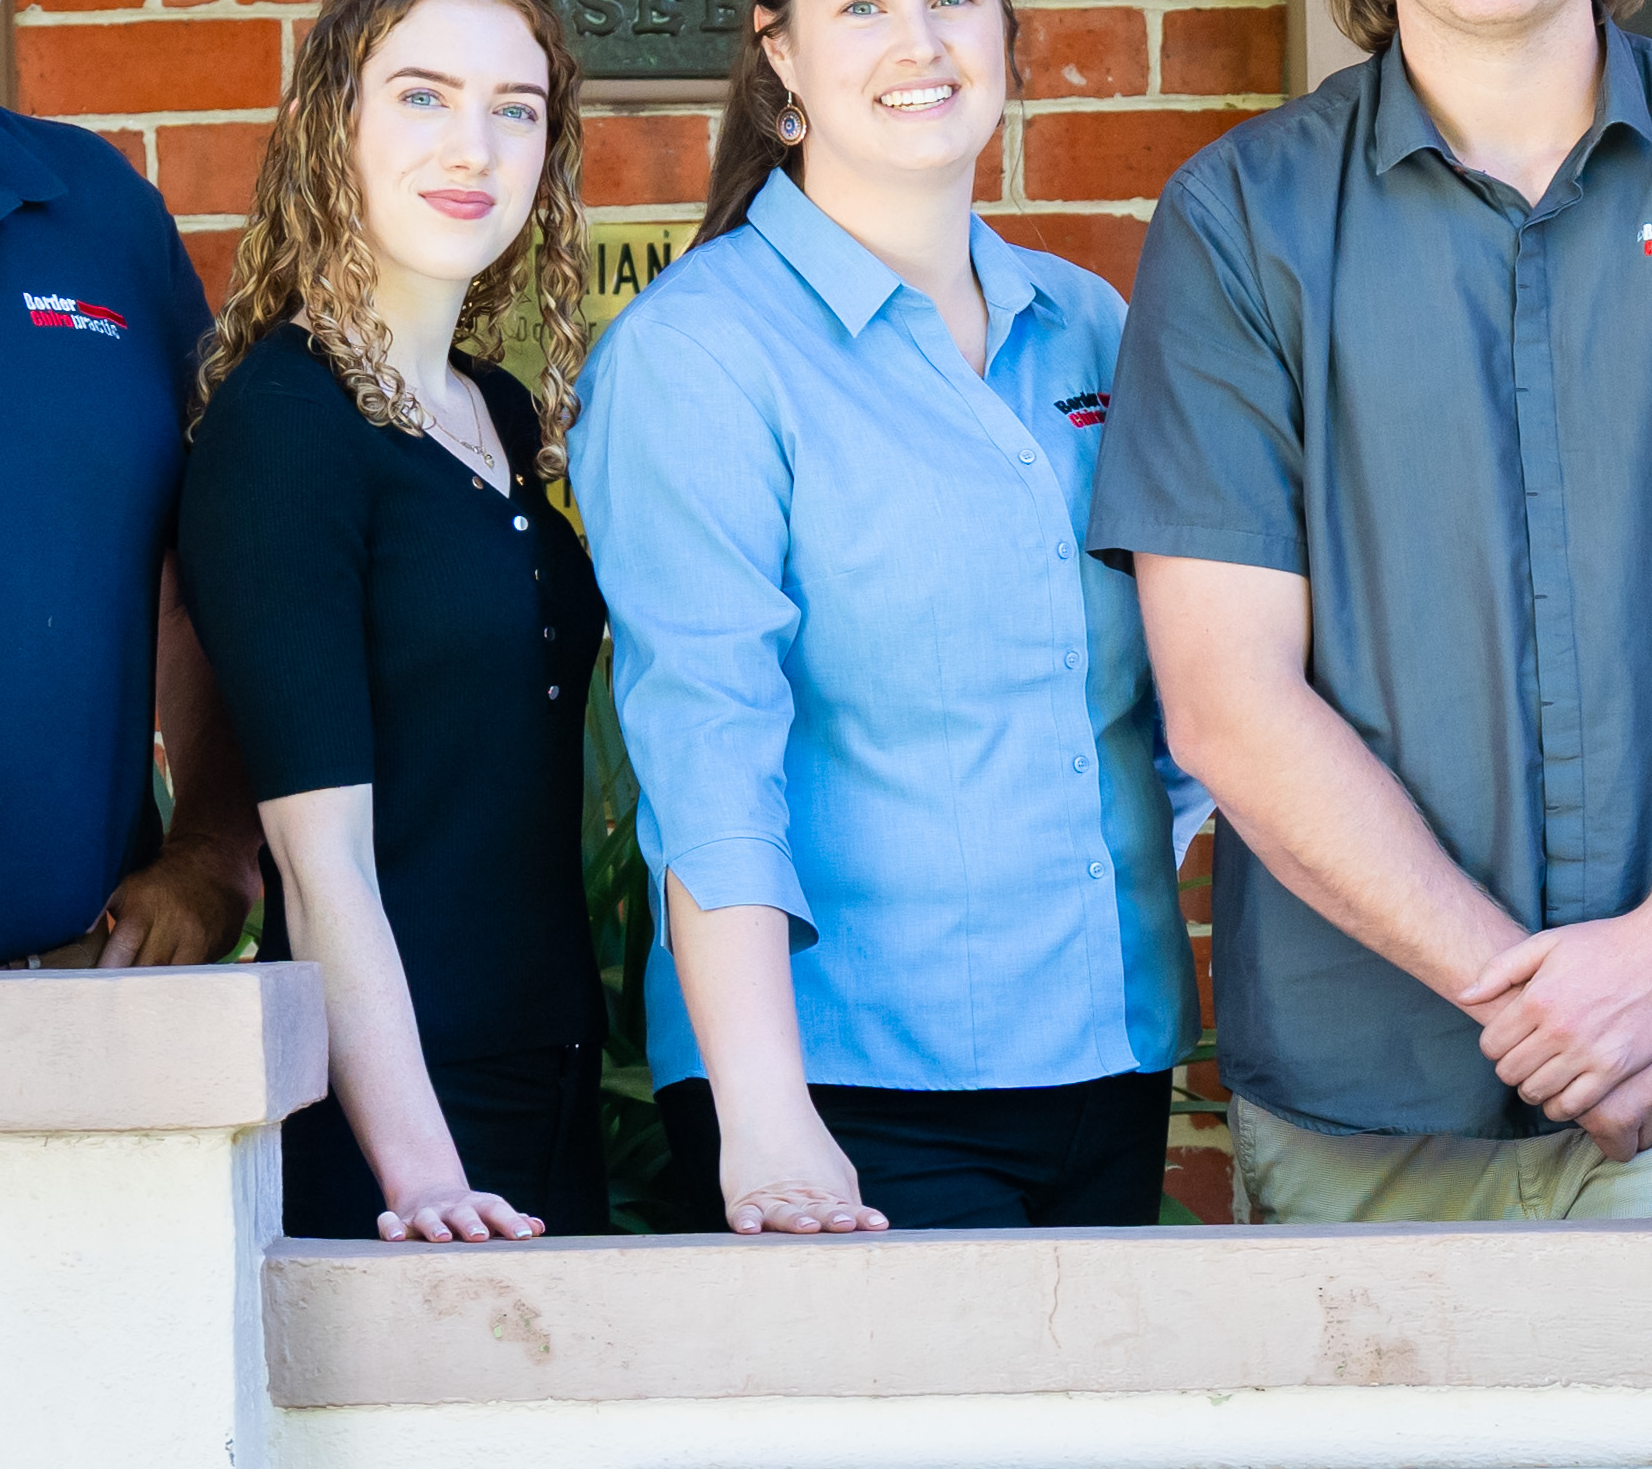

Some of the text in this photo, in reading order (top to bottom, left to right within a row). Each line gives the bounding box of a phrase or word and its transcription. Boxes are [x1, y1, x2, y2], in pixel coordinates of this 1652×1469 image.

[535, 242, 672, 296] IAN
[22, 292, 78, 313] Border
[29, 309, 121, 340] Chiropractic
